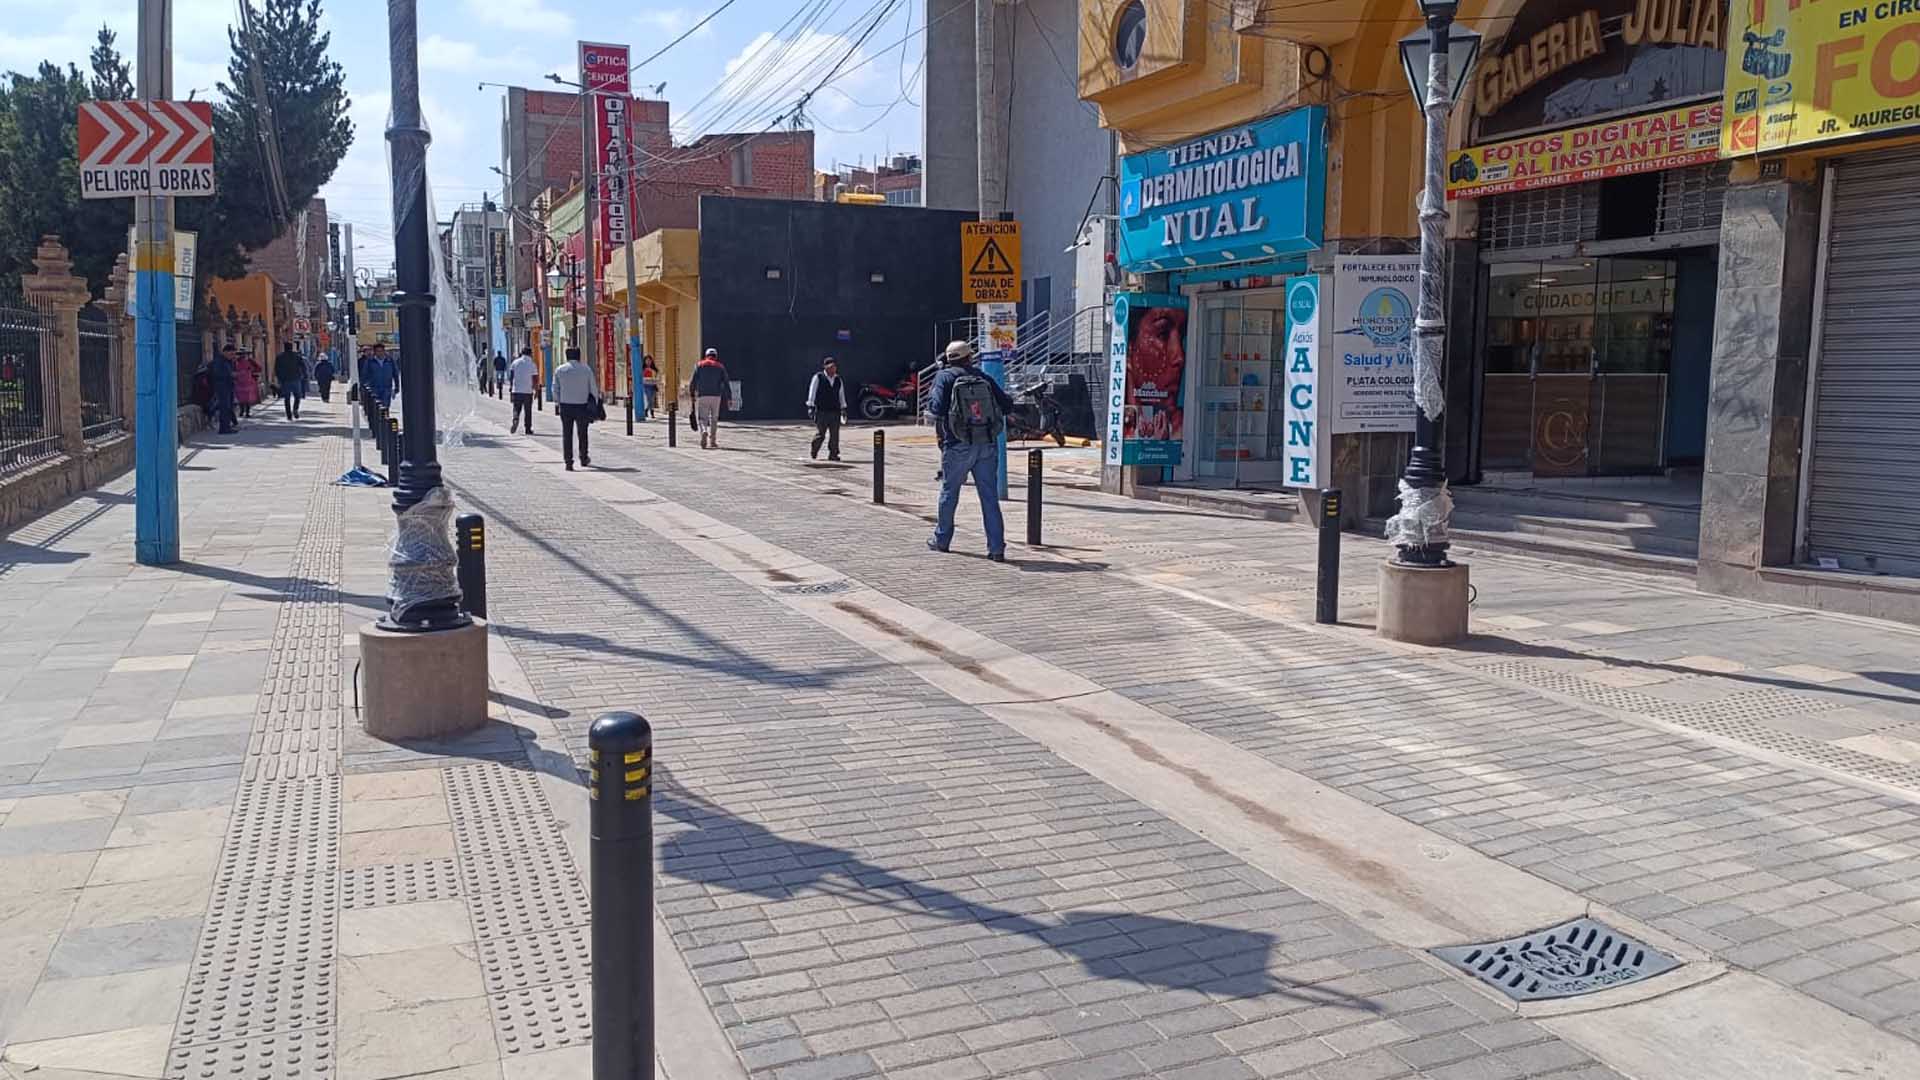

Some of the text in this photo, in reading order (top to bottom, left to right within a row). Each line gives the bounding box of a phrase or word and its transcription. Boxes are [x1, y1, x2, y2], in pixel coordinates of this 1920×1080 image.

[1621, 0, 1725, 48] JULIA
[1839, 6, 1867, 28] EN
[1474, 9, 1603, 117] GALERIA
[1483, 136, 1563, 163] FOTOS
[1573, 105, 1722, 148] DIGITALES
[1817, 118, 1840, 134] JR.
[1167, 128, 1255, 167] TIENDA
[1514, 159, 1542, 177] AL
[1551, 133, 1686, 171] INSTANTE
[83, 168, 212, 192] PELIGRO OBRAS
[1142, 141, 1300, 209] DERMATOLOGICA
[1455, 181, 1514, 197] PASAPORTE
[1526, 173, 1572, 187] CARNET
[966, 224, 1017, 235] ATENCION
[1161, 196, 1265, 246] NUAL
[1399, 263, 1421, 272] SISTE
[969, 278, 1015, 289] ZONA DE
[975, 289, 1009, 300] OBRAS
[1523, 292, 1595, 309] CUIDADO
[1602, 290, 1624, 305] DE
[1631, 288, 1654, 304] LA
[1343, 352, 1414, 368] Salud y Vi
[1346, 376, 1415, 385] PLATA COLOIDA
[1109, 343, 1125, 460] MANCHAS
[1288, 347, 1314, 483] ACNE
